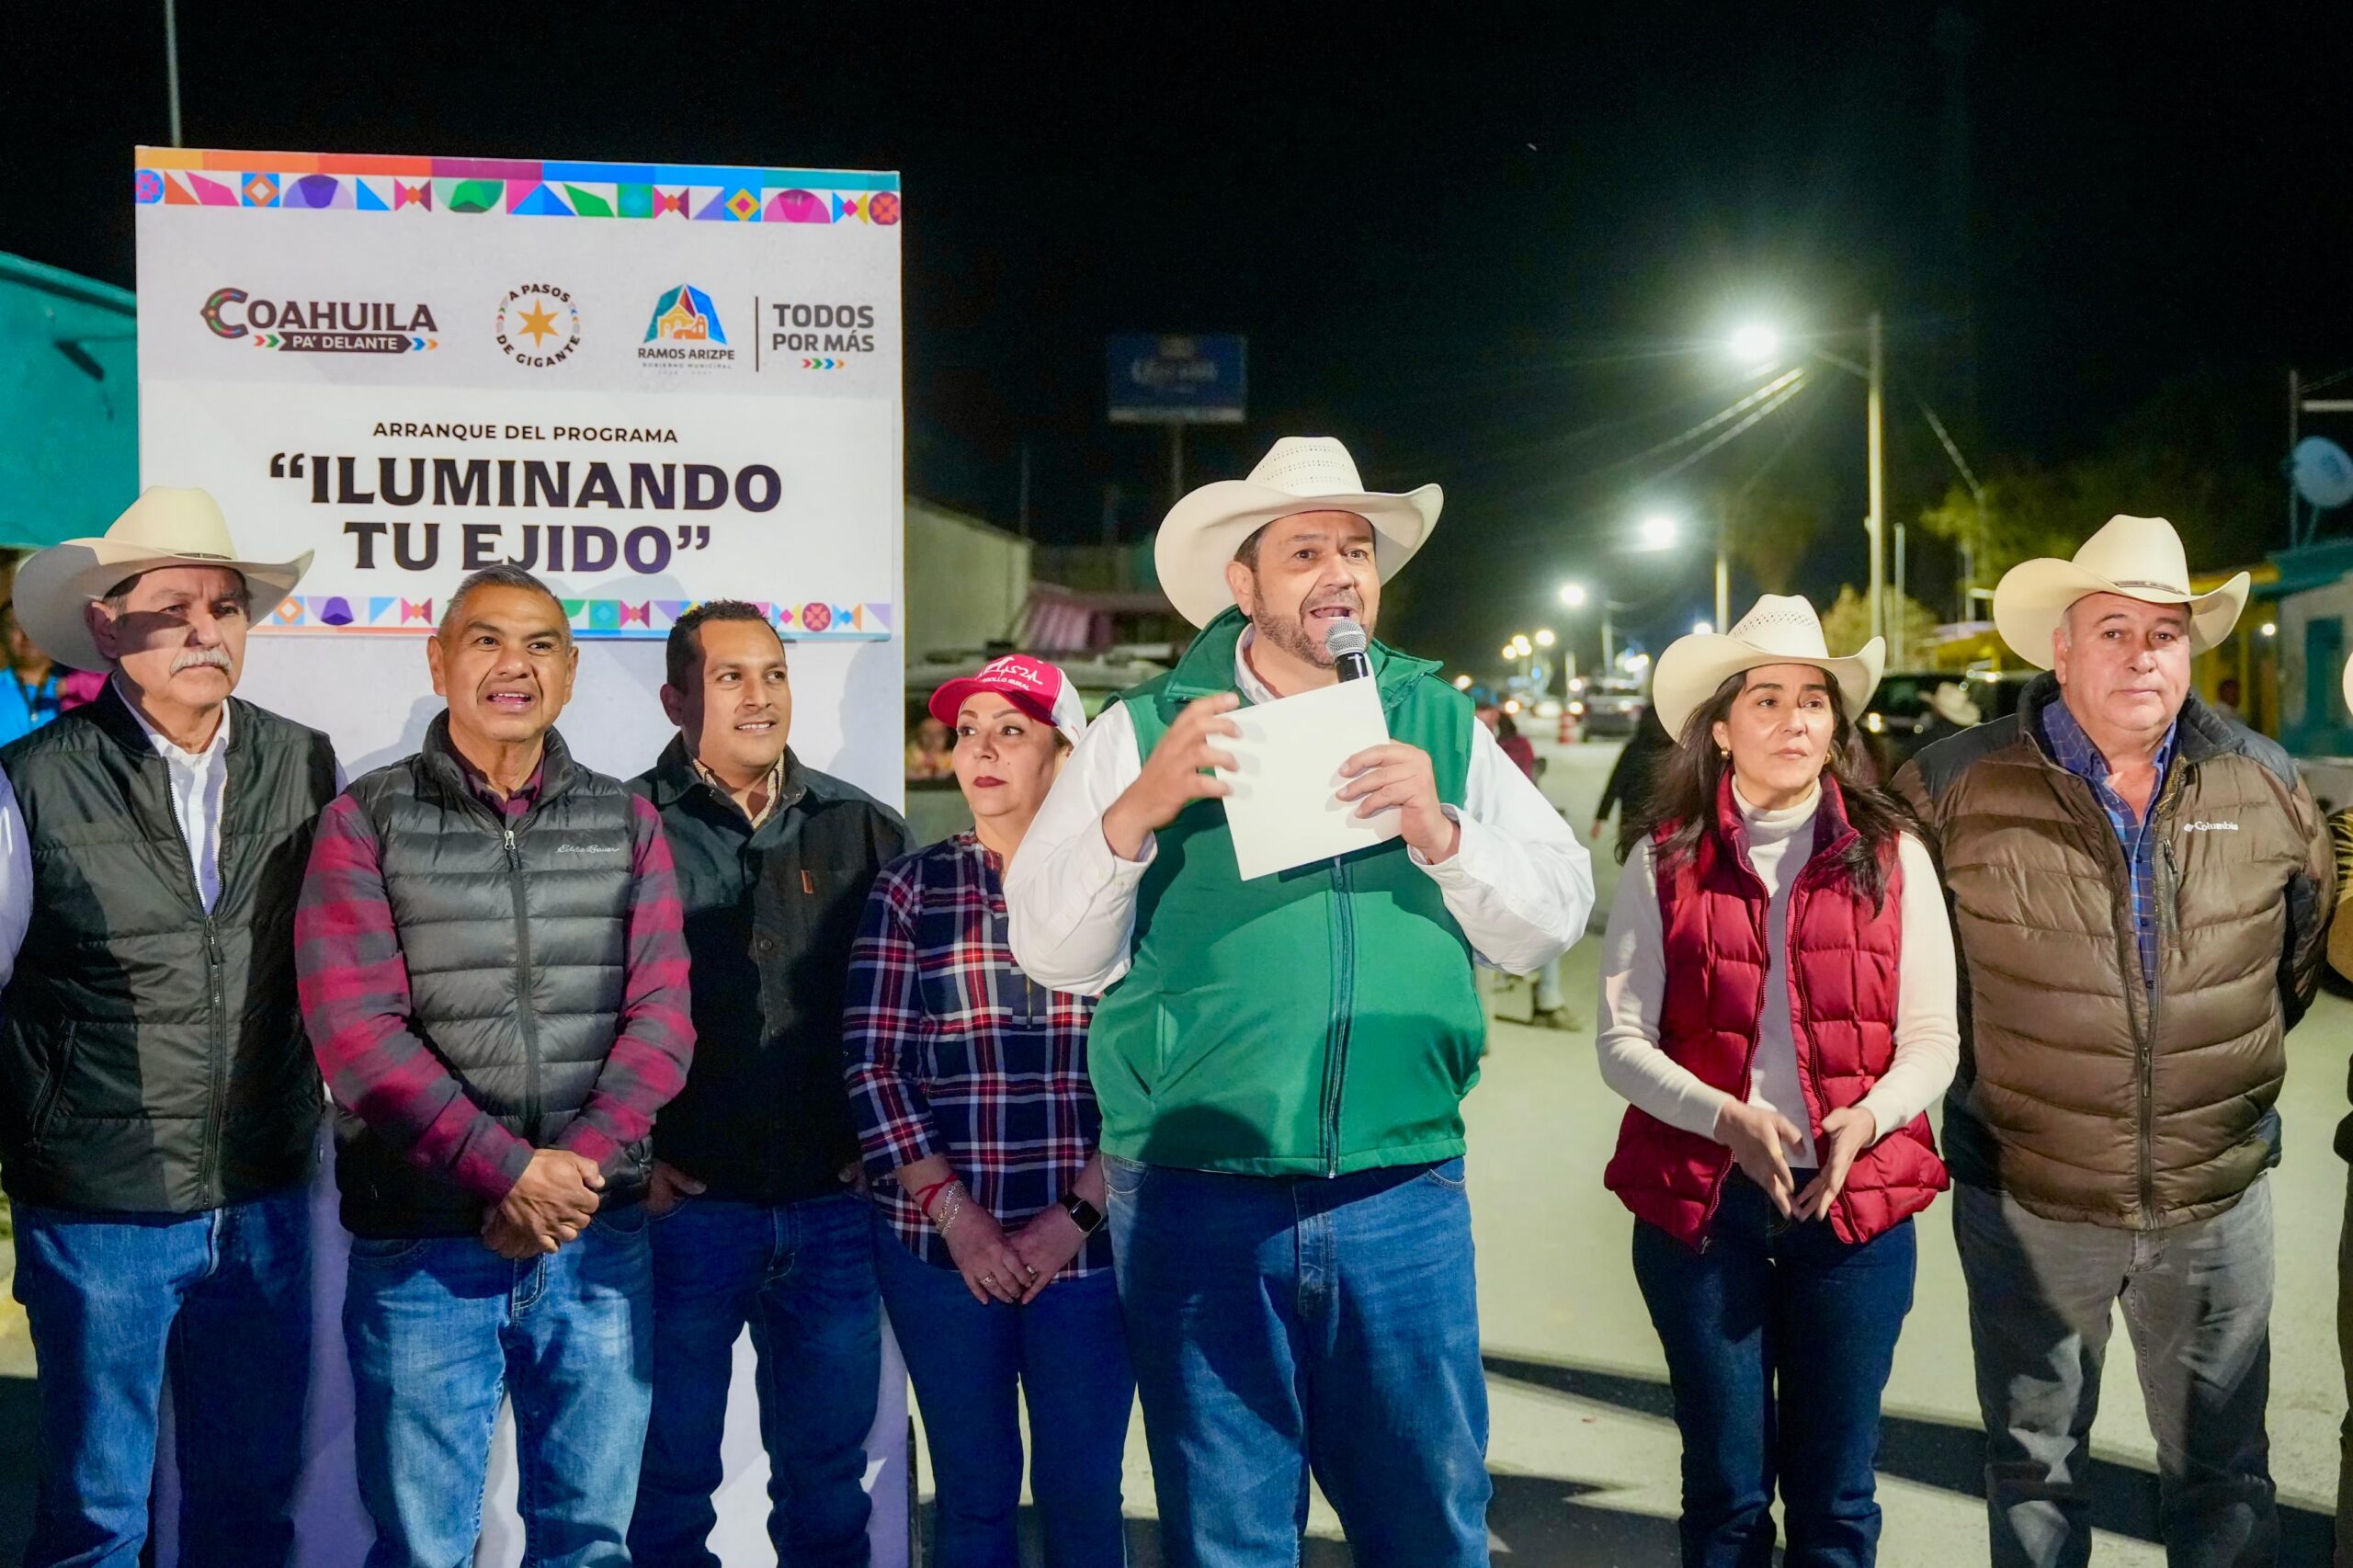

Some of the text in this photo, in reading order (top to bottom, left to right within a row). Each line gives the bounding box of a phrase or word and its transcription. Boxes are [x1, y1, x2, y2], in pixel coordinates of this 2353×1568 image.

[508, 284, 571, 302] A PASOS
[200, 287, 438, 339] COAHUILA
[773, 304, 874, 328] TODOS
[322, 336, 397, 350] DELANTE
[496, 335, 580, 367] DE GIGANTE
[773, 330, 874, 353] POR MÁS
[638, 347, 735, 360] RAMOS ARIZPE
[373, 423, 678, 443] ARRANQUE DEL PROGRAMA
[344, 522, 441, 570] TU
[2194, 821, 2239, 831] Columbia
[586, 844, 620, 854] Bauer
